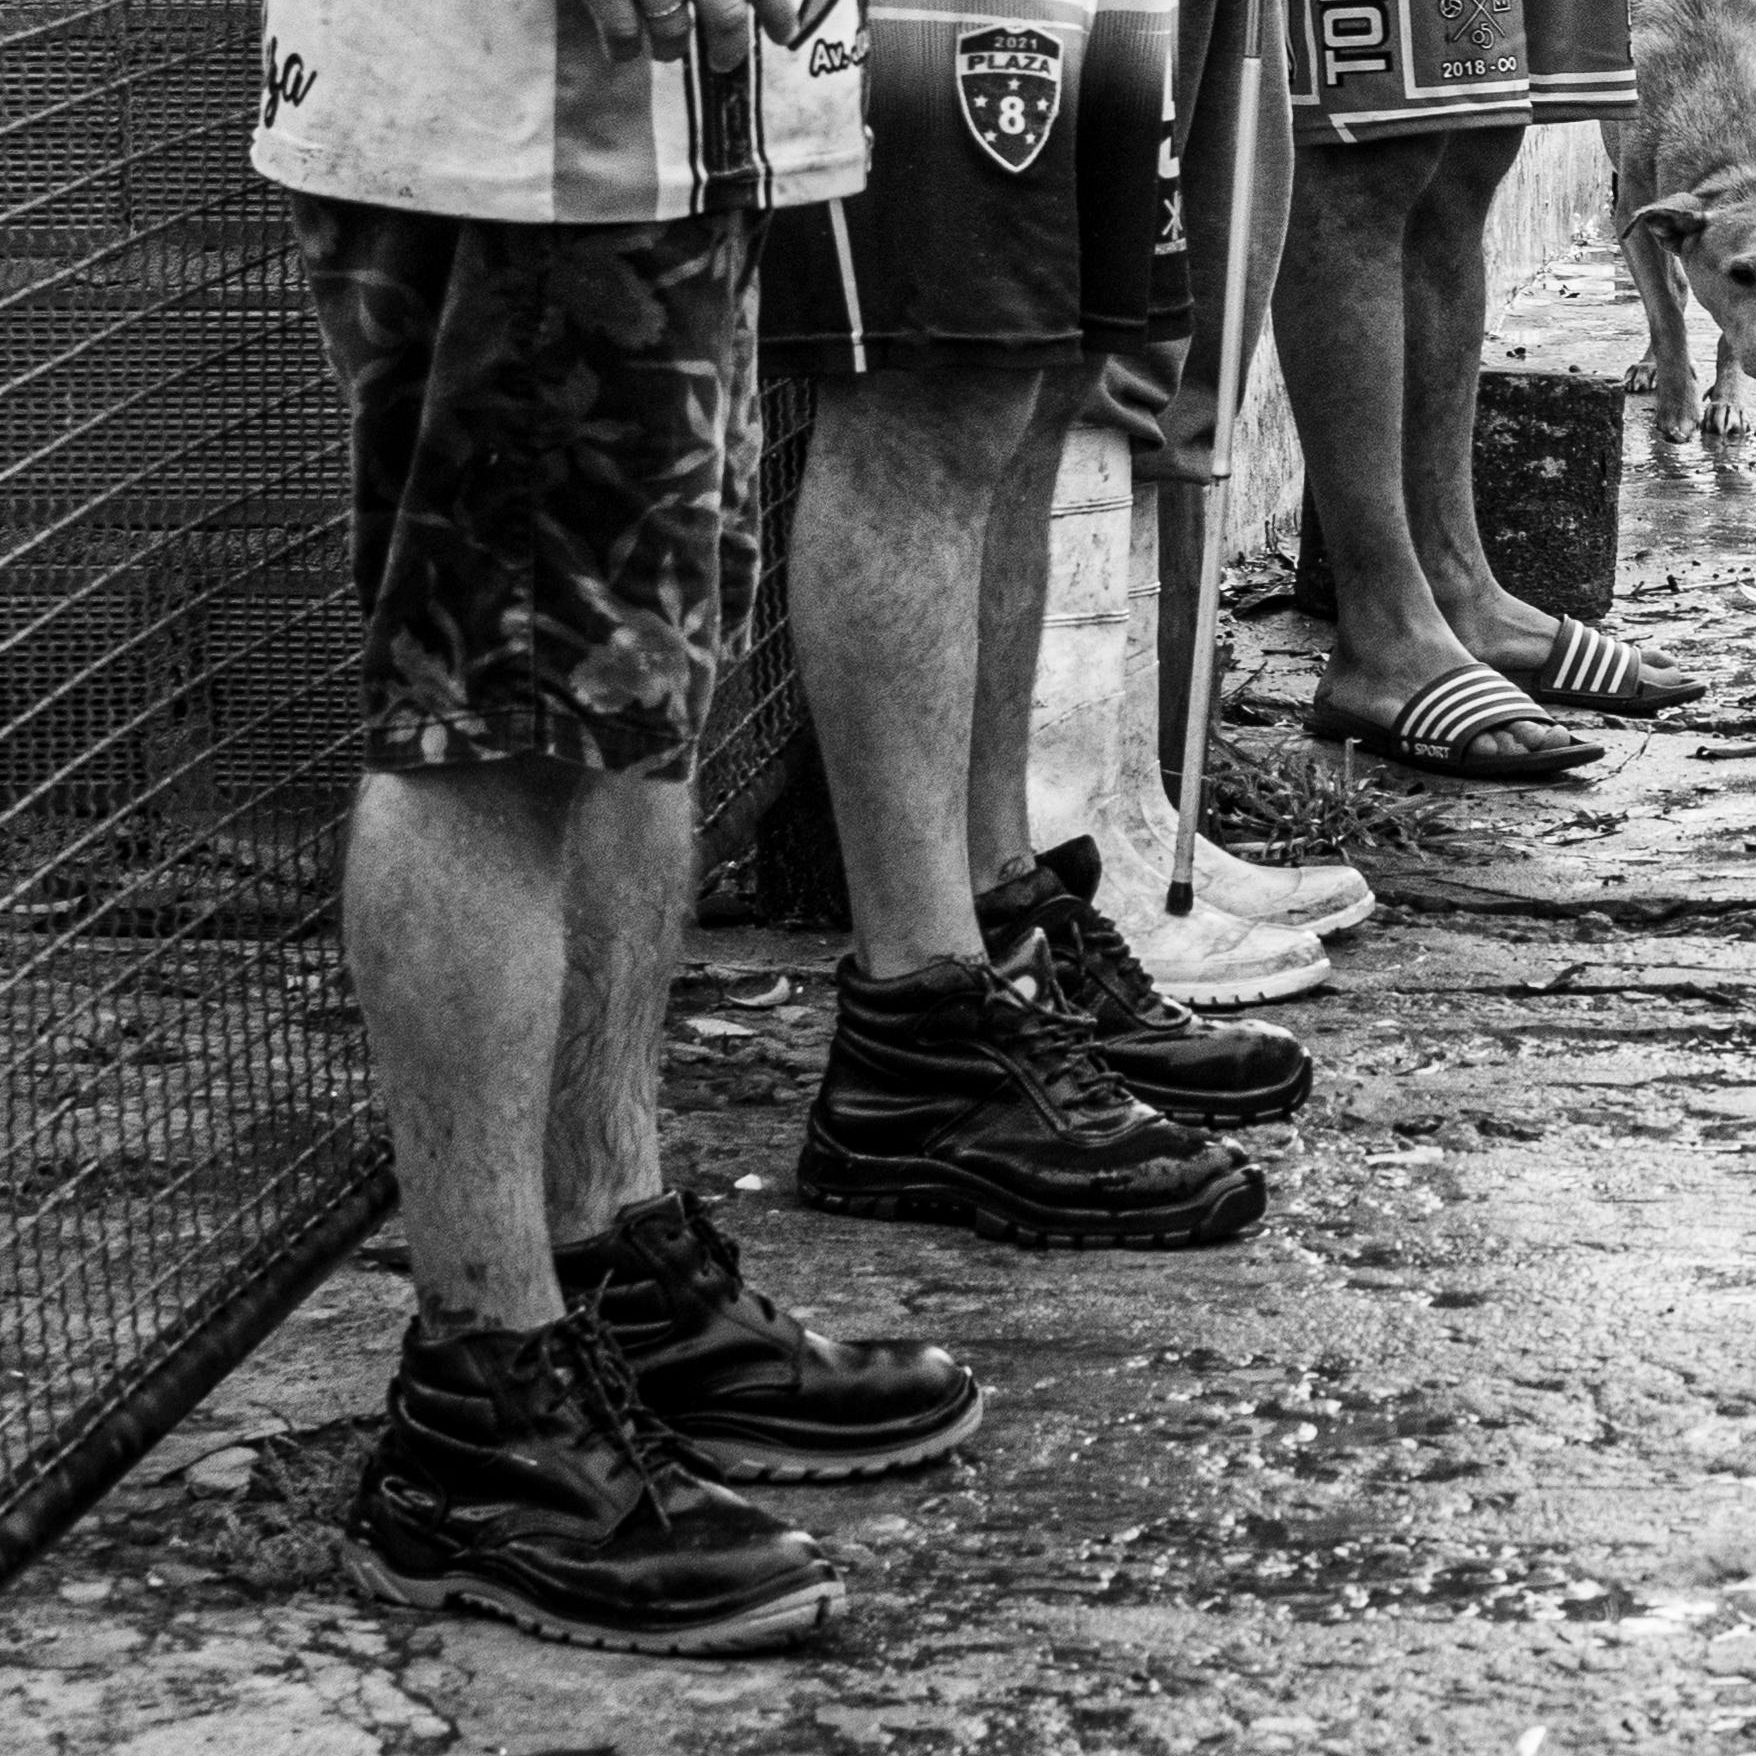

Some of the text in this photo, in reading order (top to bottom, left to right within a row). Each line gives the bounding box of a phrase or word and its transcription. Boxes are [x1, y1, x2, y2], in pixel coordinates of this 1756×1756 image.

[994, 36, 1039, 51] 2021
[967, 54, 1051, 74] PLAZA
[998, 95, 1026, 135] 8
[1414, 743, 1450, 759] SPORT
